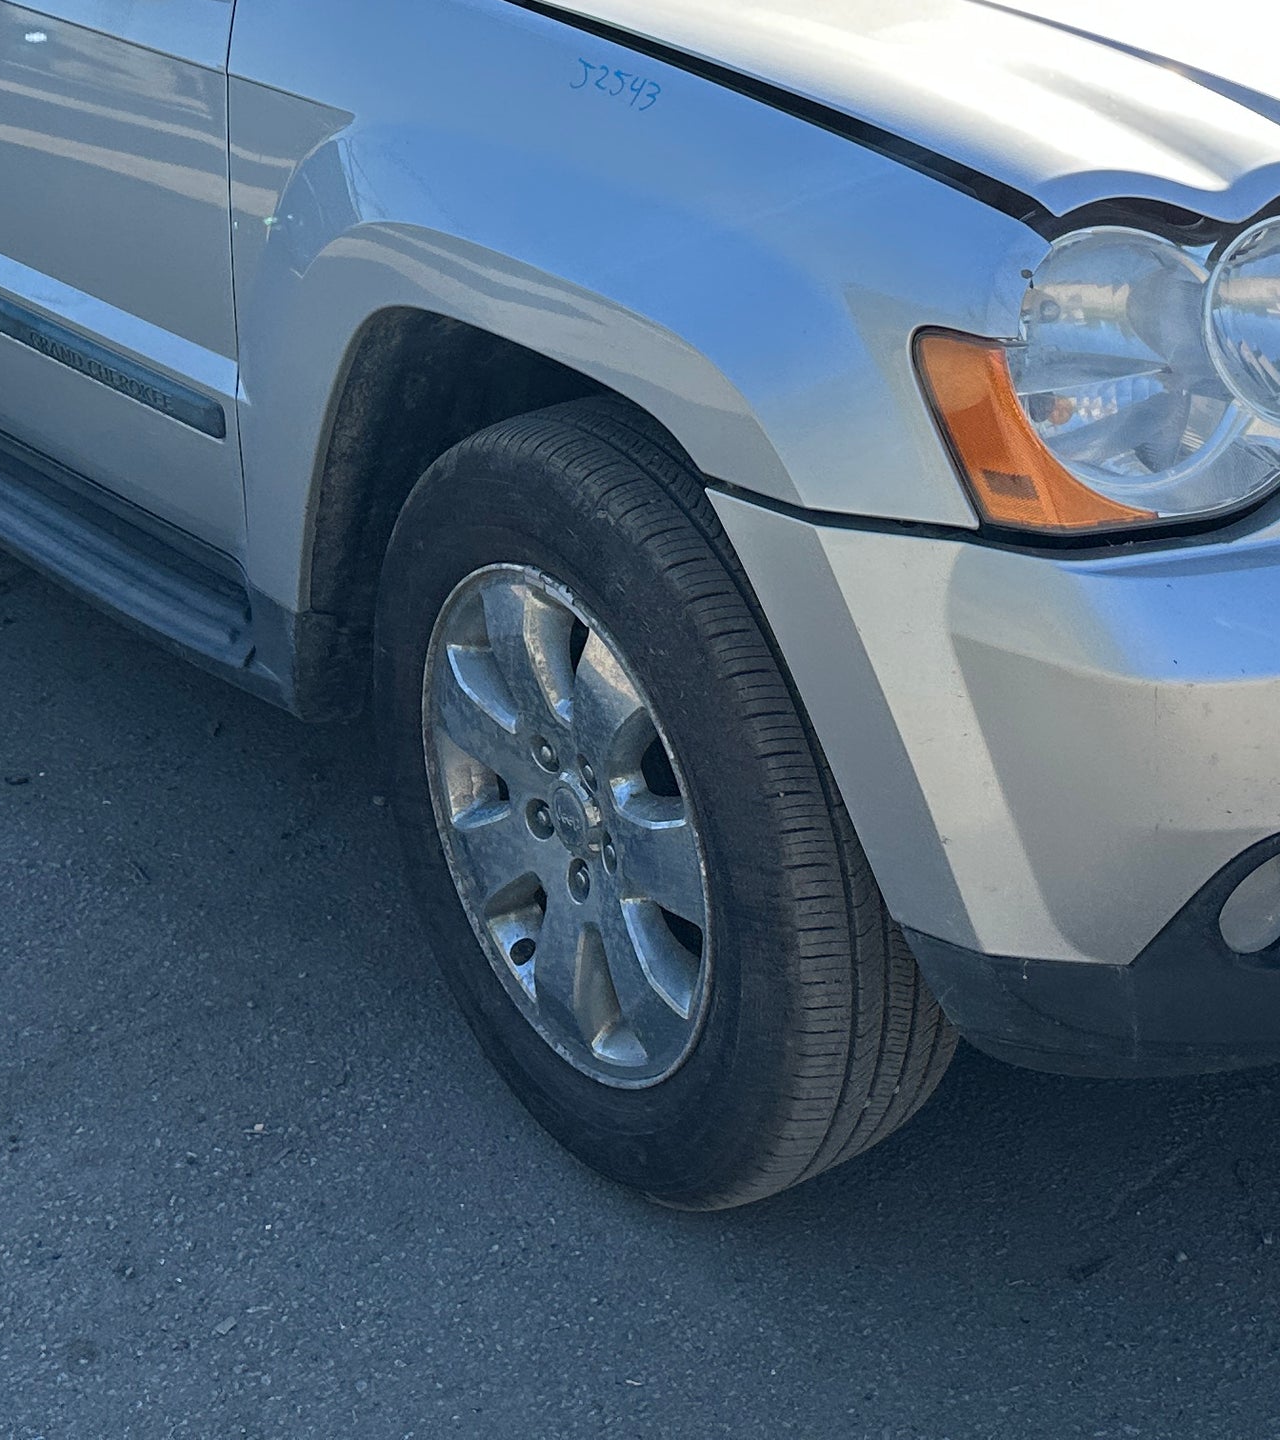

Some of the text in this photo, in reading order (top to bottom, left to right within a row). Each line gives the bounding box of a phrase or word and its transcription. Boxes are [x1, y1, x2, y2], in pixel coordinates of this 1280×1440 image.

[569, 58, 662, 111] J2543
[29, 329, 173, 411] GRAND CHEROKEE
